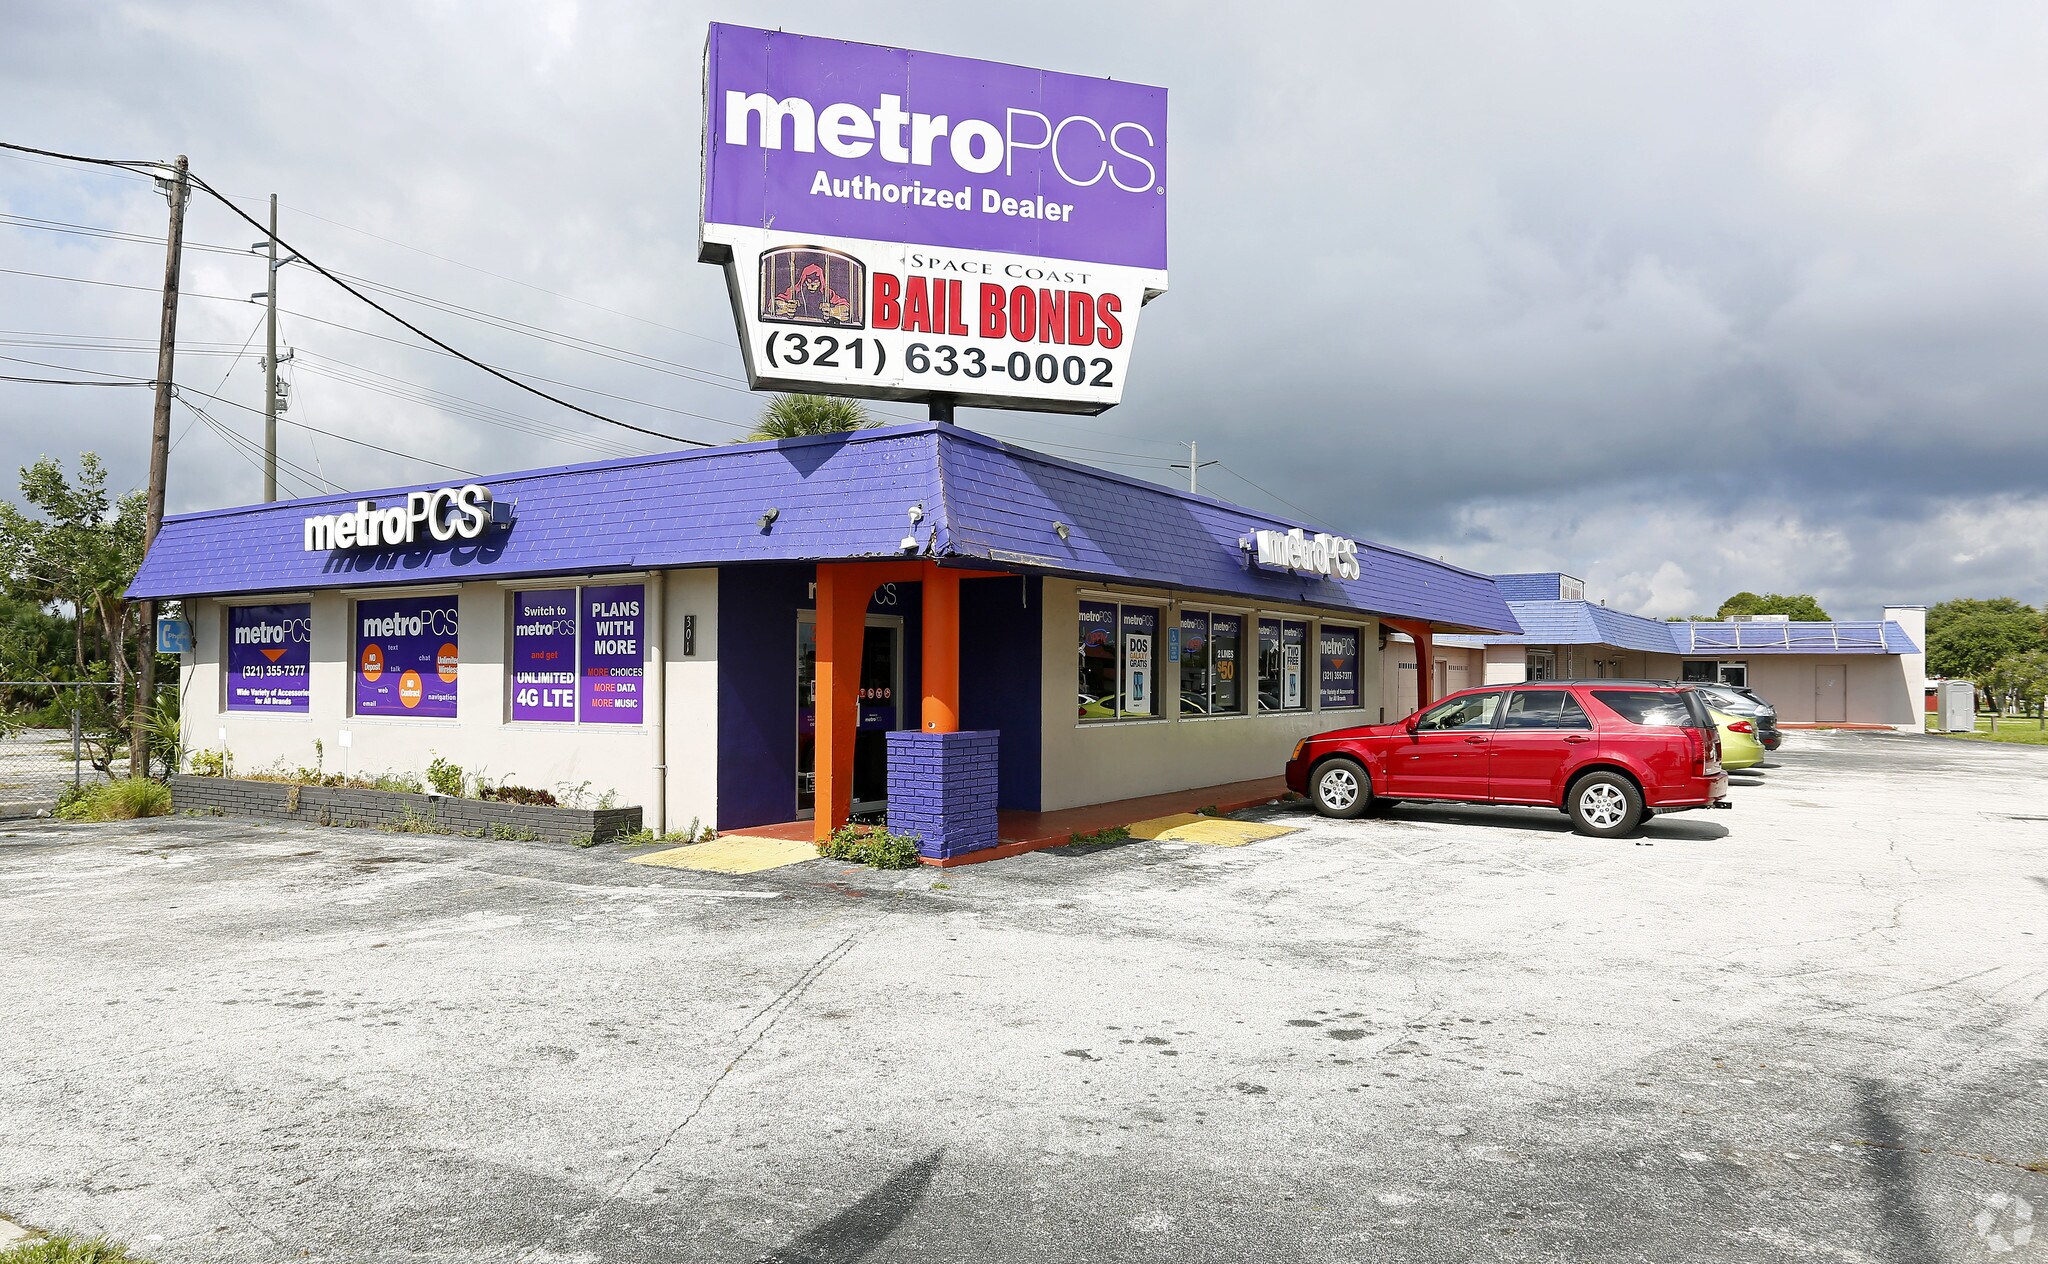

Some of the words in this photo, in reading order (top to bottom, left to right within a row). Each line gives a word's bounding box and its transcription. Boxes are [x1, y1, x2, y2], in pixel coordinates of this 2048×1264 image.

[724, 89, 1156, 194] metroPCS
[810, 170, 972, 212] Authorized
[982, 188, 1074, 223] Dealer
[911, 254, 993, 275] SPACE
[1004, 264, 1091, 285] COAST
[872, 272, 969, 337] BAIL
[980, 282, 1123, 349] BONDS
[765, 330, 886, 375] (321)
[905, 342, 1114, 388] 633-0002
[304, 484, 488, 551] metroPCS
[1257, 528, 1360, 580] metroPCS
[524, 605, 555, 616] Switch
[557, 605, 567, 616] to
[592, 601, 640, 618] PLANS
[364, 608, 458, 637] metroPCS
[1078, 610, 1113, 623] metroPCS
[1123, 615, 1154, 627] metroPCS
[516, 619, 575, 636] metroPCS
[596, 620, 634, 636] WITH
[594, 639, 637, 655] MORE
[1130, 638, 1148, 653] DOS
[1288, 646, 1299, 657] TWO
[369, 654, 376, 662] NO
[437, 656, 458, 664] Unlimite
[531, 651, 544, 659] and
[545, 651, 559, 661] get
[1130, 652, 1147, 660] GALAXY
[1287, 656, 1299, 666] FREE
[364, 663, 381, 672] Deposit
[1130, 659, 1148, 668] GRATIS
[243, 665, 264, 680] (321)
[266, 665, 306, 677] 355-7377
[587, 667, 609, 676] MORE
[610, 667, 643, 677] CHOICES
[1217, 661, 1234, 680] $50
[407, 680, 414, 688] NO
[516, 672, 574, 684] UNLIMITED
[236, 688, 250, 697] Wide
[251, 688, 270, 698] Variety
[271, 688, 277, 697] of
[277, 688, 310, 697] Accessorie
[400, 689, 420, 697] Contract
[594, 683, 615, 692] MORE
[616, 683, 637, 692] DATA
[428, 693, 457, 702] navigation
[516, 688, 539, 707] 4G
[542, 689, 574, 708] LTE
[591, 698, 613, 707] MORE
[614, 698, 638, 708] MUSIC
